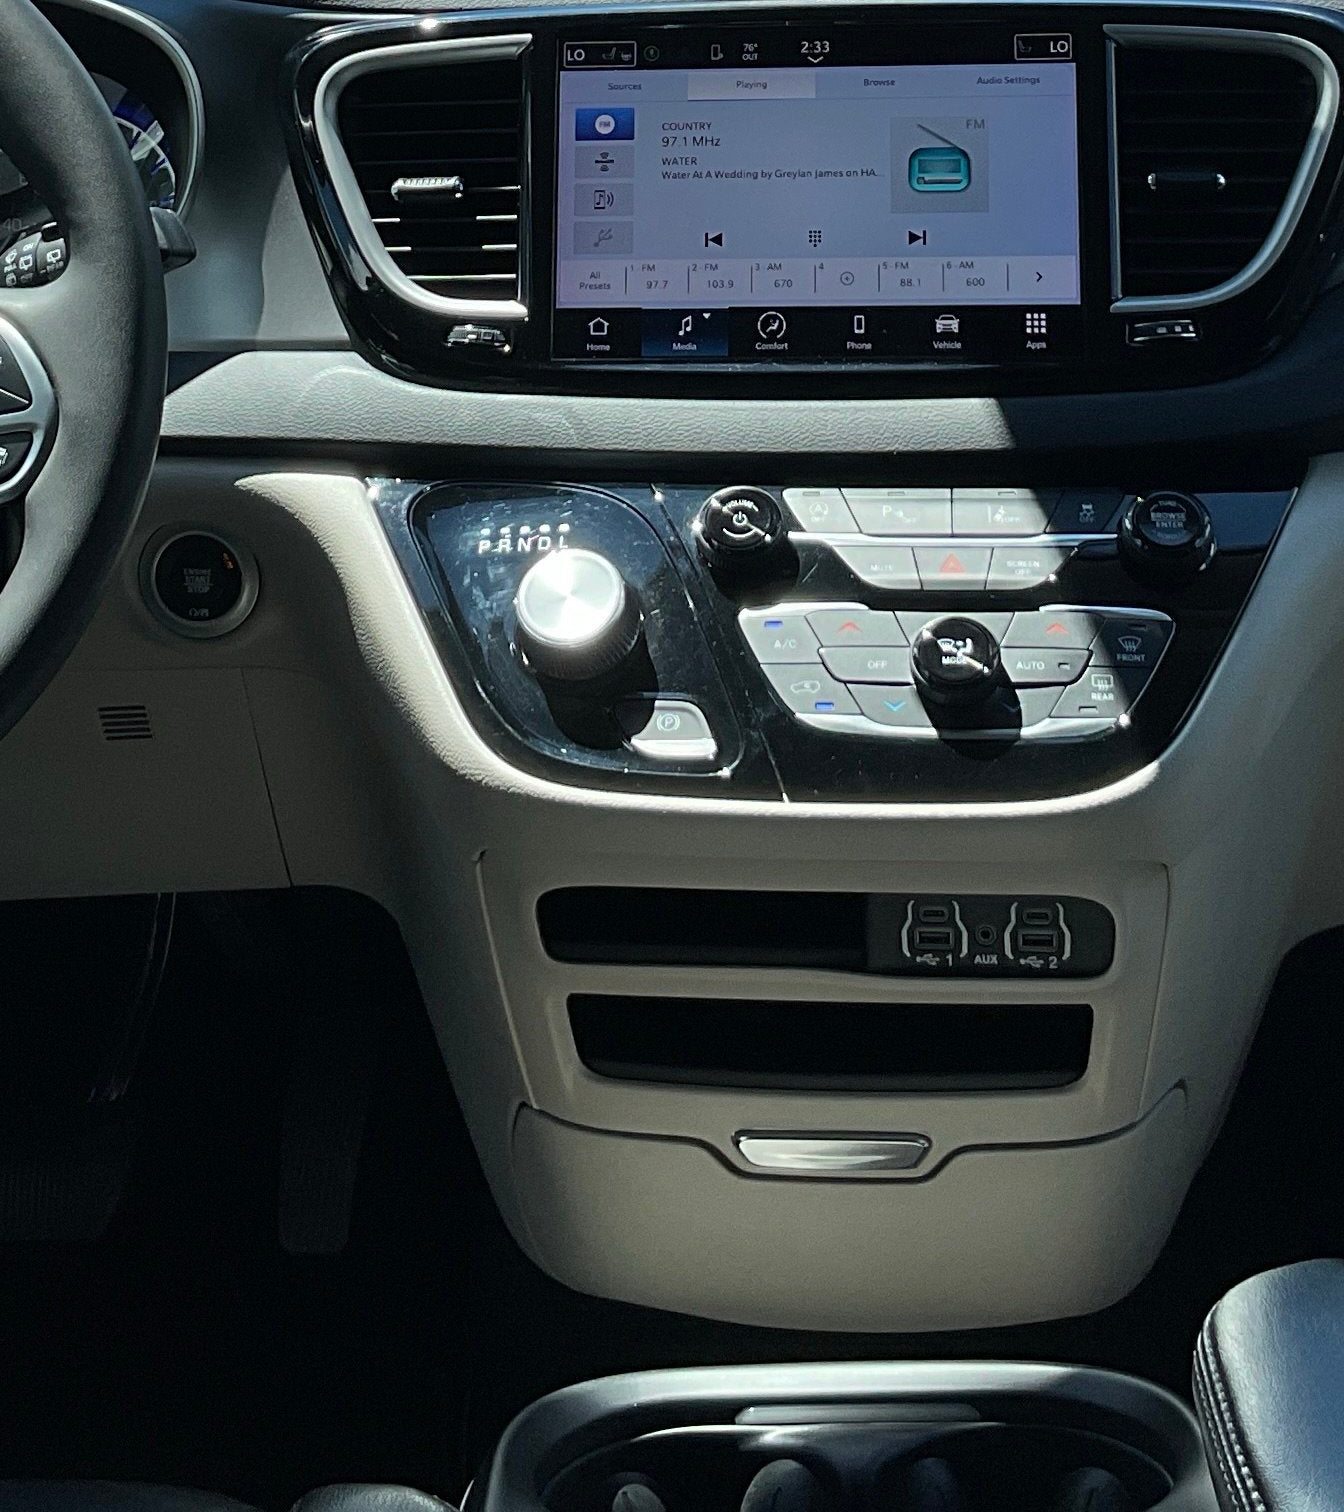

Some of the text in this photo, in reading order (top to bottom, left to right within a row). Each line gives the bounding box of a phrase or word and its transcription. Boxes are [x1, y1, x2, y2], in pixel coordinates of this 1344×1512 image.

[800, 41, 830, 54] 2:33
[1050, 41, 1069, 53] LO
[567, 49, 585, 62] LO
[736, 80, 768, 90] Playing
[863, 78, 896, 87] Browse
[976, 75, 1041, 86] Audio Settings
[607, 82, 642, 91] Sources
[662, 122, 712, 131] COUNTRY
[966, 119, 986, 130] FM
[661, 136, 721, 148] 97.1 MHz
[662, 156, 698, 166] WATER
[661, 171, 691, 180] Water
[692, 171, 703, 180] At
[705, 171, 713, 179] A
[714, 170, 758, 181] Wedding
[760, 169, 773, 181] by
[815, 169, 844, 180] James
[845, 170, 858, 178] on
[704, 263, 719, 272] FM
[767, 263, 782, 271] AM
[895, 262, 909, 270] FM
[959, 261, 974, 270] AM
[589, 271, 601, 280] All
[579, 282, 611, 290] Presets
[646, 280, 669, 289] 97.7
[707, 280, 734, 289] 103.9
[774, 279, 793, 288] 670
[900, 278, 921, 287] 88.1
[966, 277, 985, 287] 600
[586, 343, 610, 352] Home
[673, 342, 697, 351] Media
[755, 342, 788, 351] Comfort
[847, 341, 872, 350] Phone
[933, 340, 962, 350] Vehicle
[1026, 341, 1047, 351] Apps
[1006, 560, 1040, 568] SCREEN
[774, 639, 797, 649] A/C
[1116, 653, 1146, 662] FRONT
[867, 660, 888, 669] OFF
[1015, 661, 1045, 671] AUTO
[1091, 693, 1114, 701] REAR
[946, 954, 953, 966] 1
[974, 954, 998, 965] AUX
[1049, 957, 1058, 969] 2
